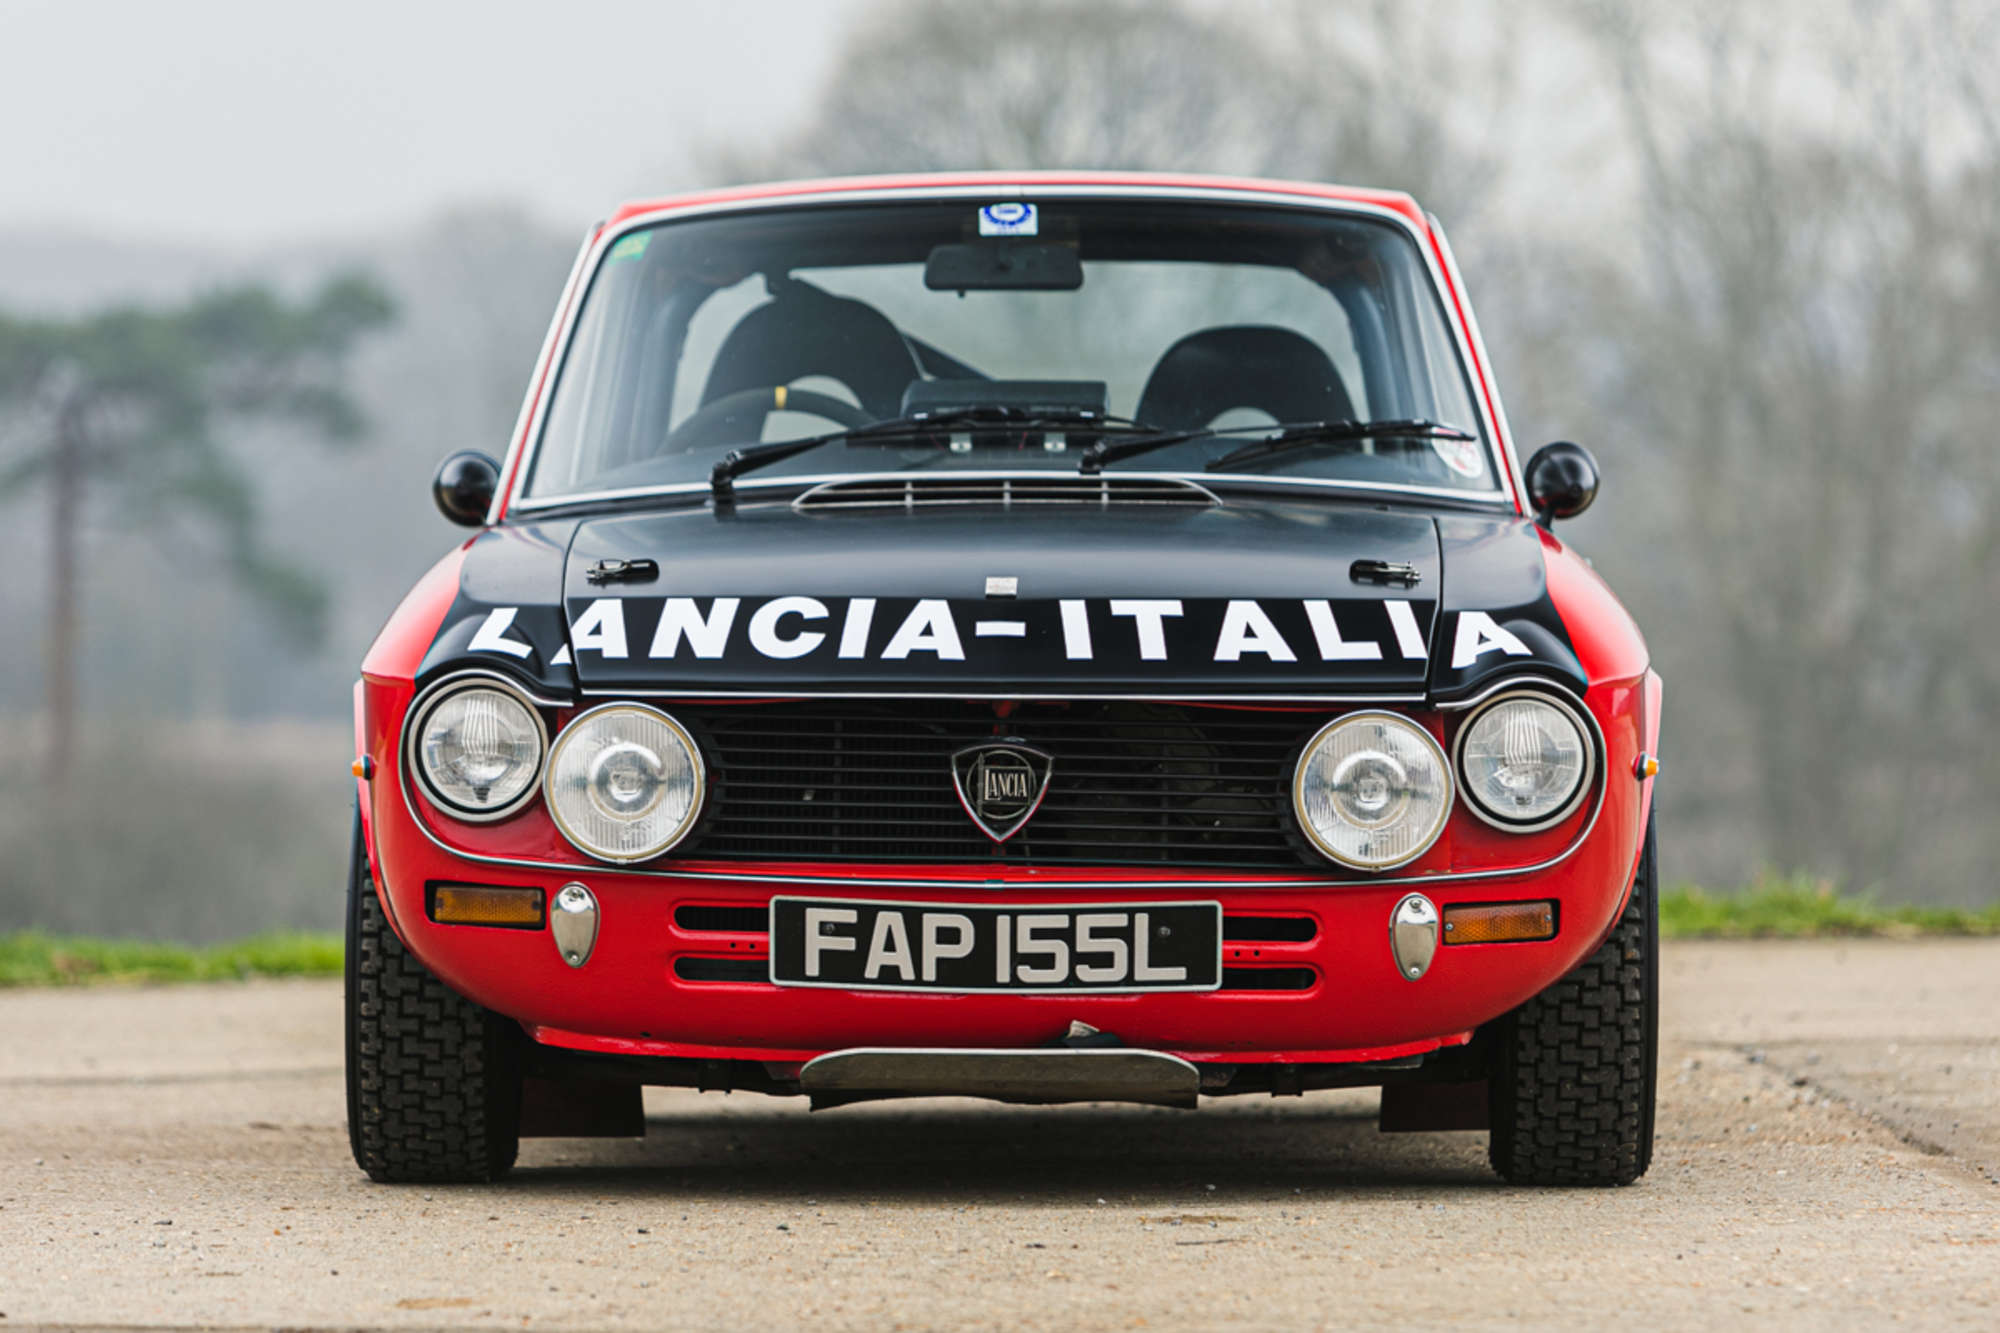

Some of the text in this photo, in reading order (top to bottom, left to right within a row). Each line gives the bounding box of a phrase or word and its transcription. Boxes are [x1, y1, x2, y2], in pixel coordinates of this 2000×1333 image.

[984, 768, 1028, 801] LANCIA
[805, 907, 1187, 983] FAP 155L
